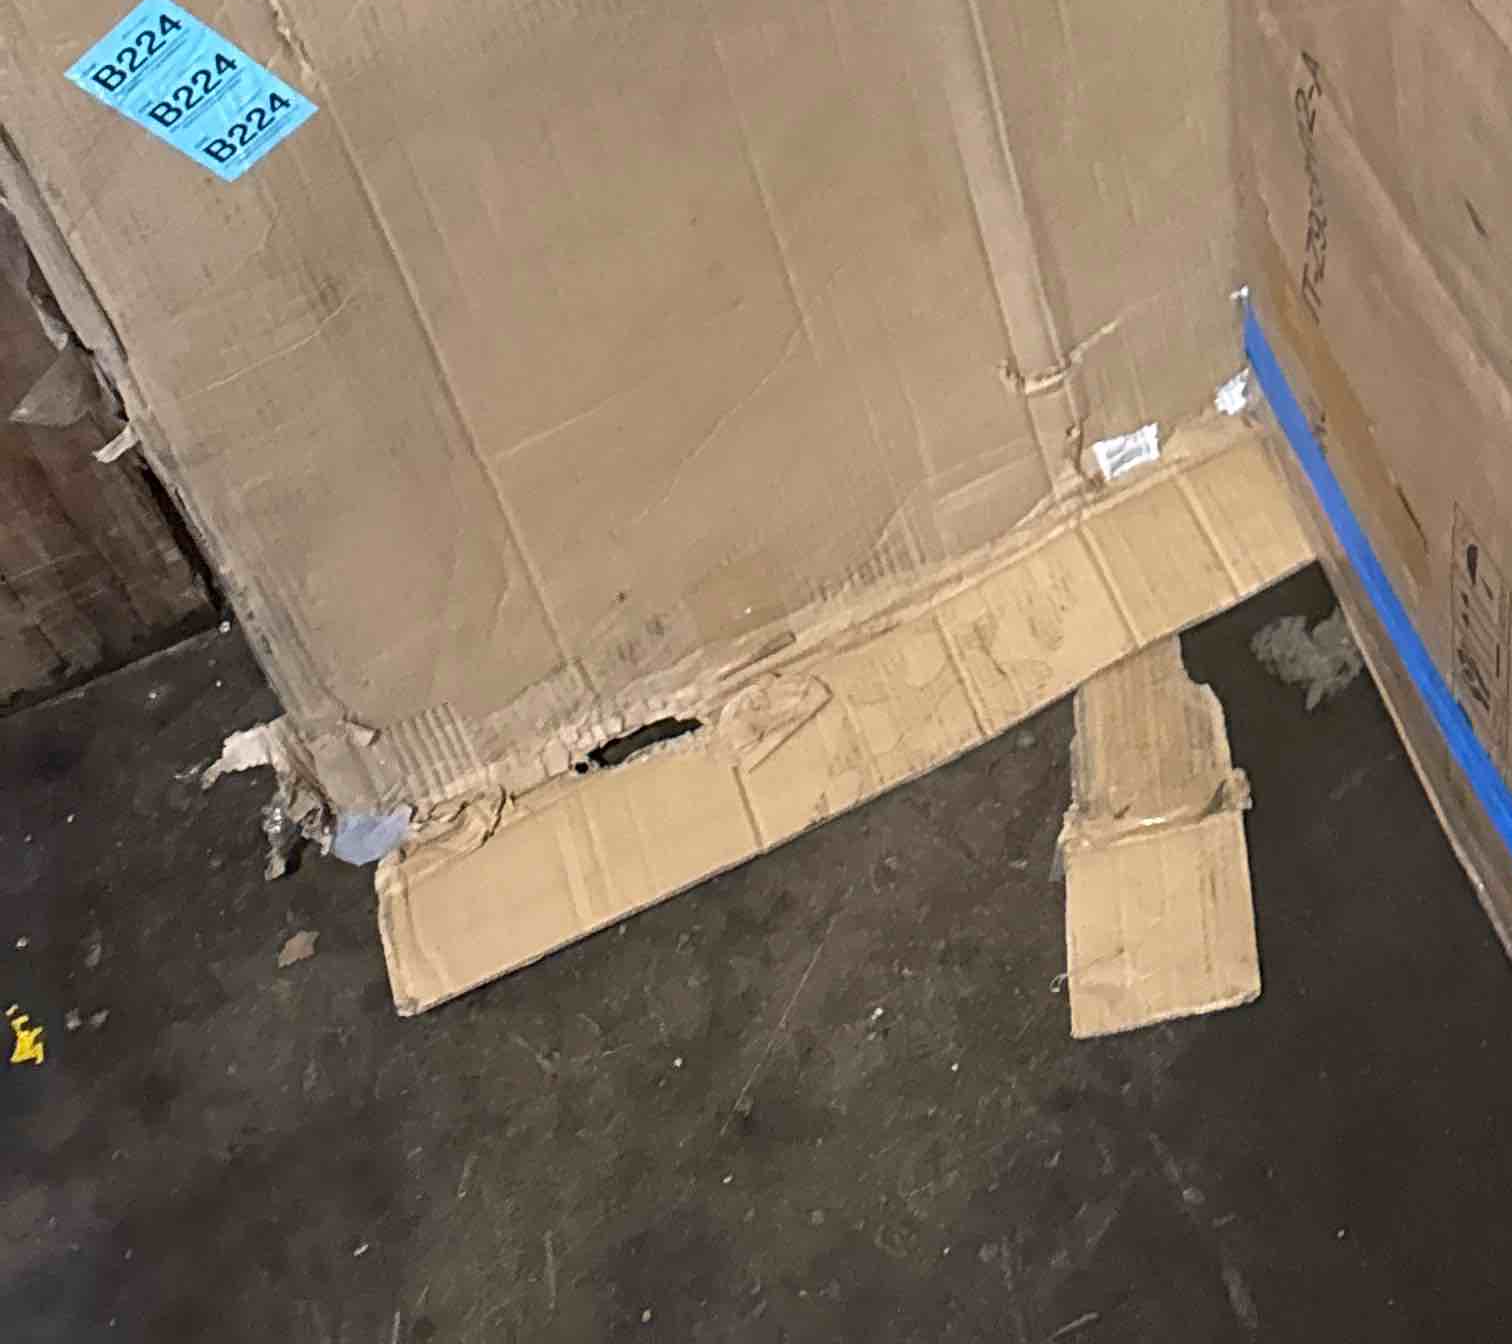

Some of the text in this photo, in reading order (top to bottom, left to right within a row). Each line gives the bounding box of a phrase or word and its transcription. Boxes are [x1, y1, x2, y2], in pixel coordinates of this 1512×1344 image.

[92, 13, 183, 93] B224
[148, 52, 238, 128] B224
[202, 91, 292, 164] B224
